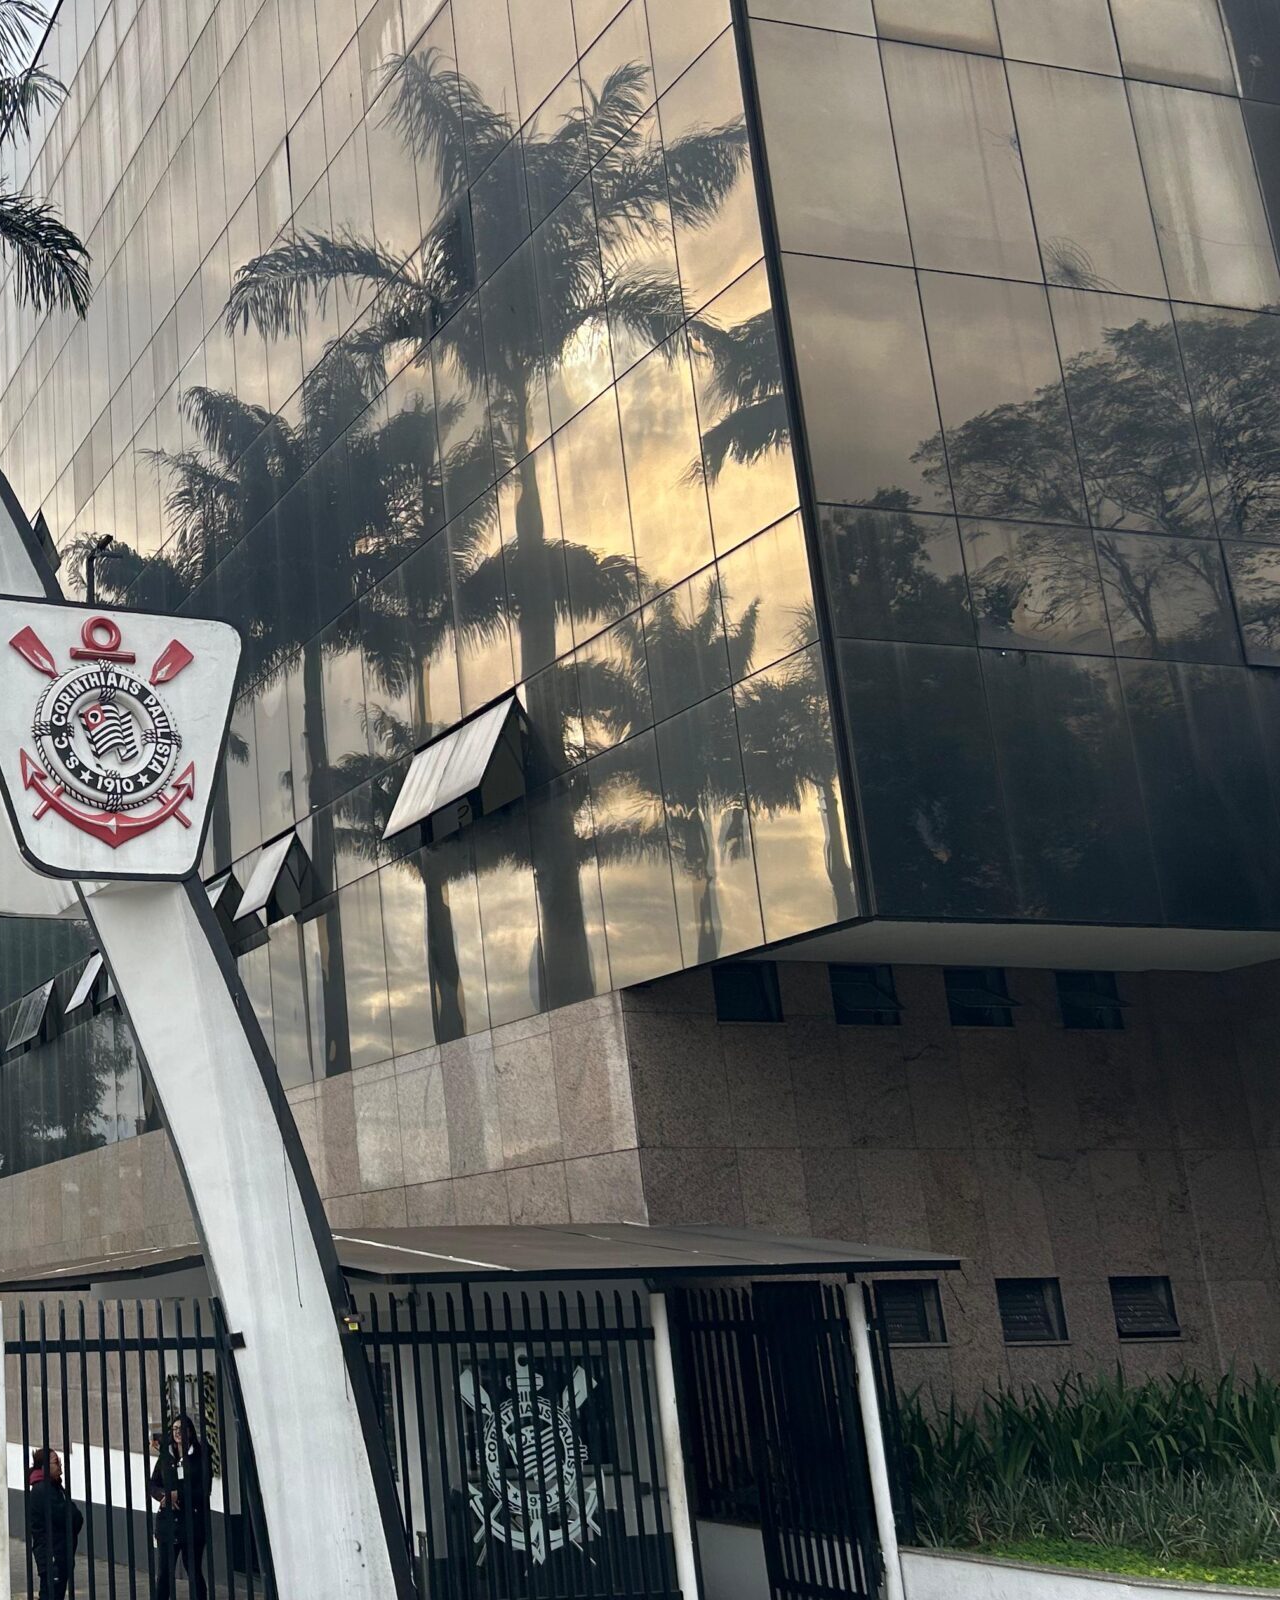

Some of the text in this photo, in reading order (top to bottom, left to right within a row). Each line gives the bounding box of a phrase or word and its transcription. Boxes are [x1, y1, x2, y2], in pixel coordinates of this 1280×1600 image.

[51, 671, 142, 727] CORINTHIANS
[143, 694, 172, 775] PAULISTA
[96, 776, 135, 794] 1910
